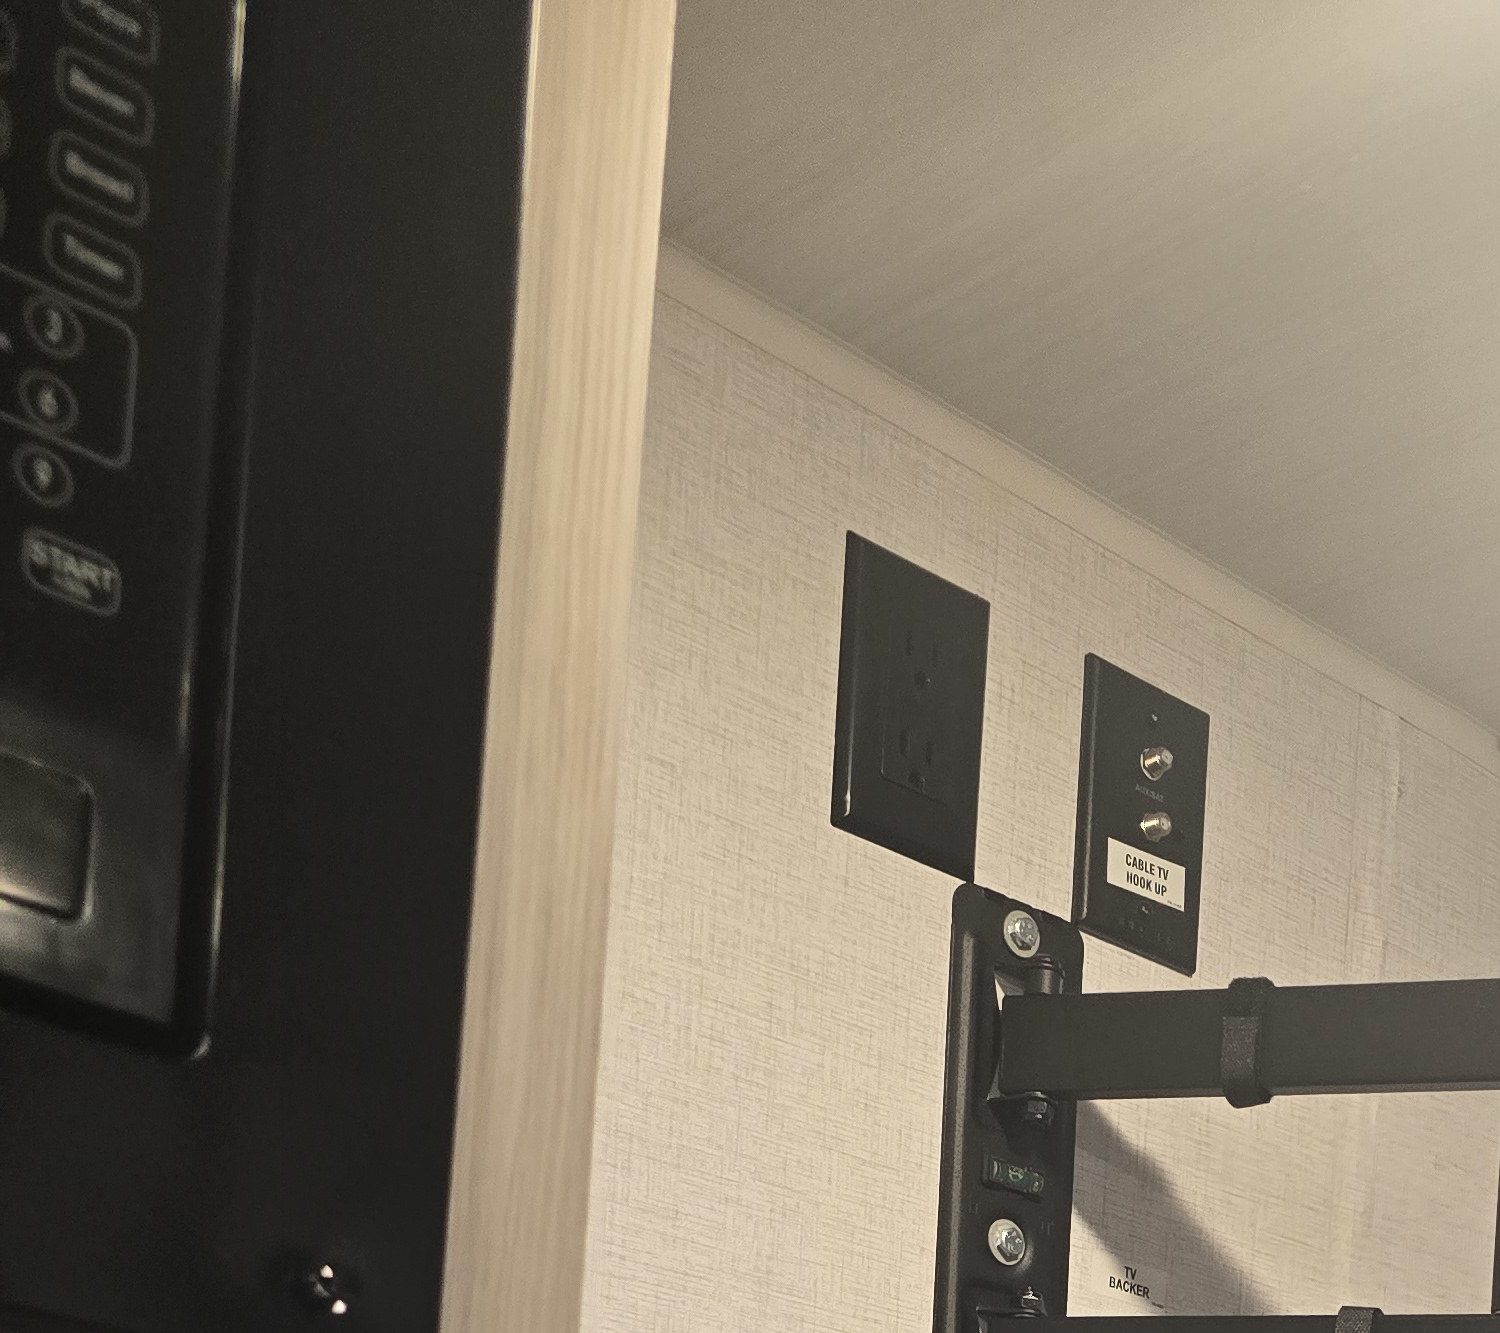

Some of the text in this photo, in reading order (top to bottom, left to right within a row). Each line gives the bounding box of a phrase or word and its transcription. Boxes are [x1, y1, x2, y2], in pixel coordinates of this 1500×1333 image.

[1125, 853, 1169, 881] CABLE TV
[1126, 870, 1167, 897] HOOK UP
[1124, 1265, 1137, 1280] TV
[1109, 1276, 1150, 1299] BACKER
